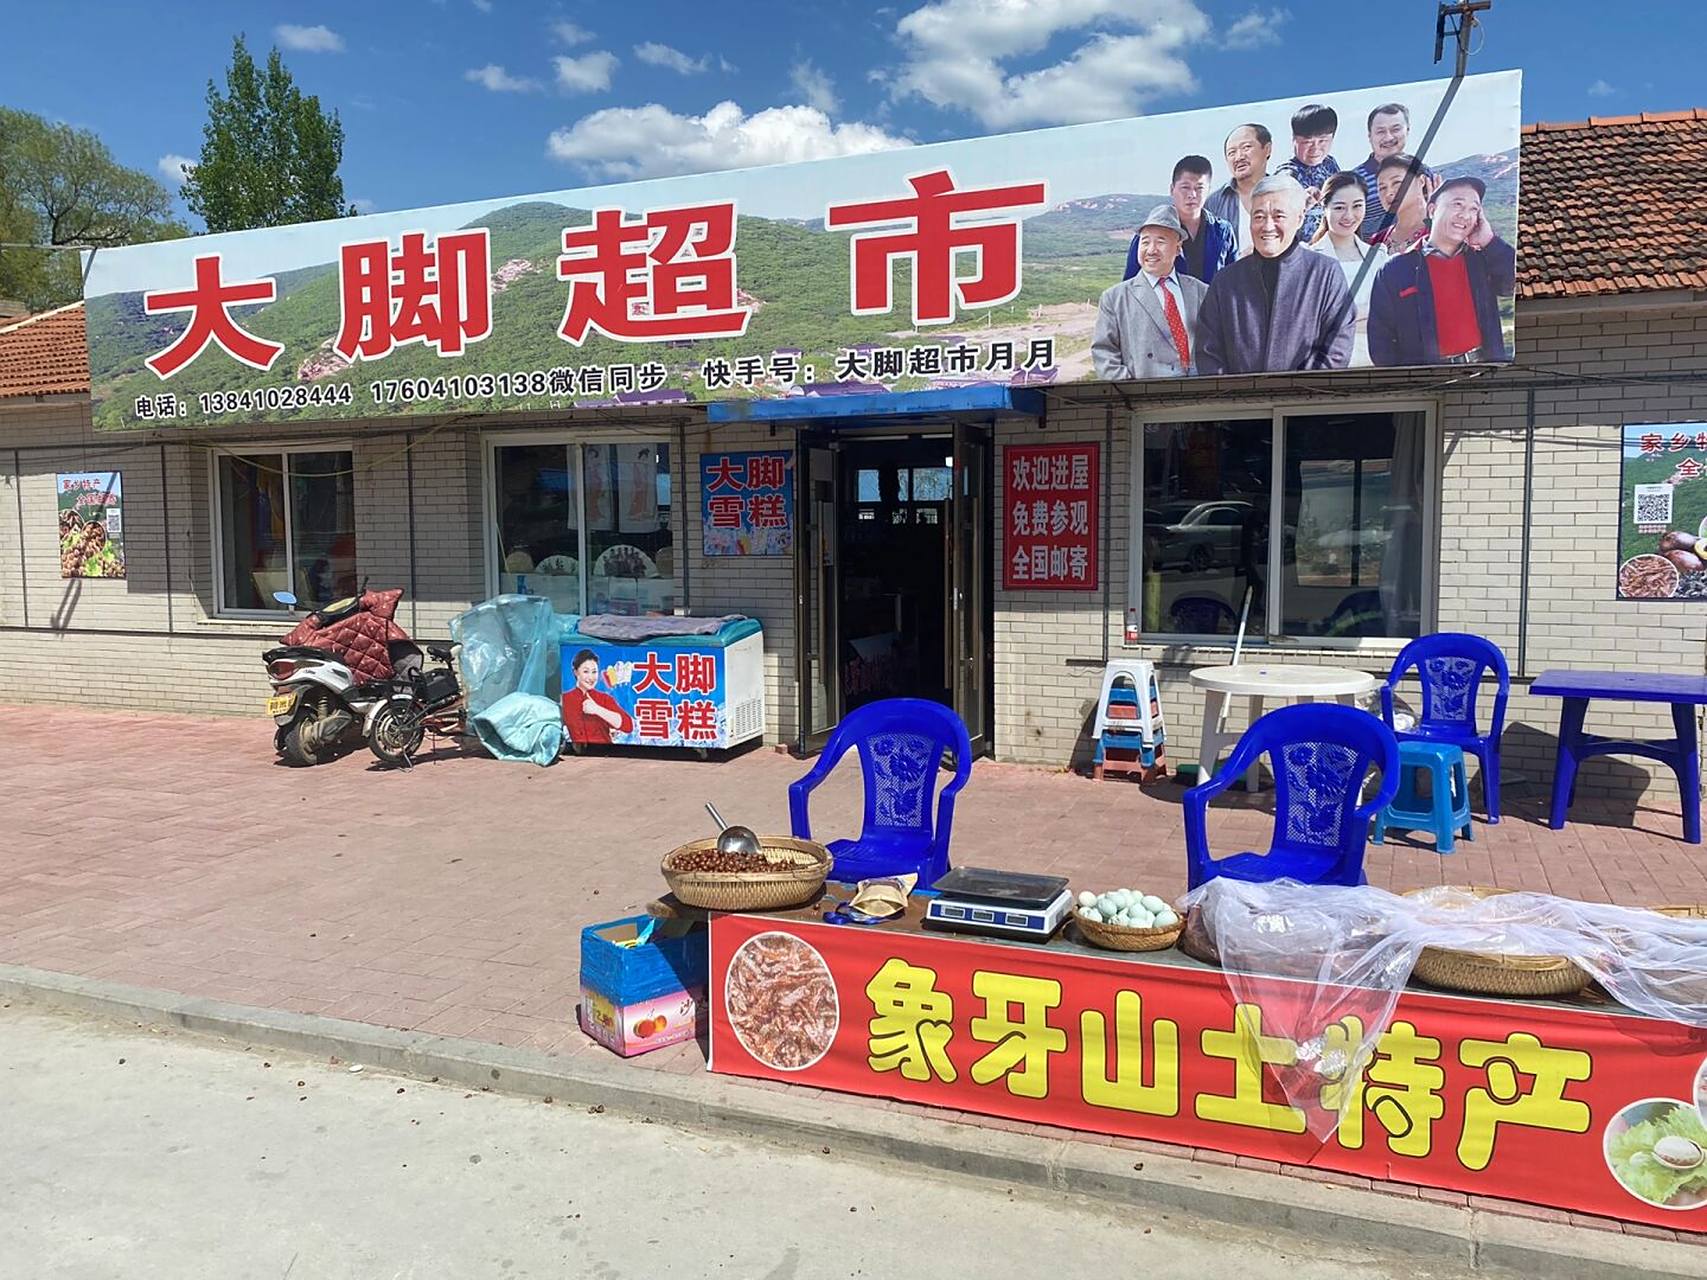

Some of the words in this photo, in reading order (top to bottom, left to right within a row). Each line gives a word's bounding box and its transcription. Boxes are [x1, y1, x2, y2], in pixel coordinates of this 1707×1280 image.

[144, 169, 1048, 379] 大脚超市
[706, 456, 785, 493] 大脚
[1012, 454, 1089, 491] 欢迎进屋
[708, 494, 788, 529] 雪糕
[1012, 500, 1089, 536] 免费参观
[1012, 544, 1088, 581] 全国邮寄
[632, 652, 716, 694] 大脚
[634, 698, 717, 740] 雪糕
[865, 957, 1593, 1171] 象牙山土特产
